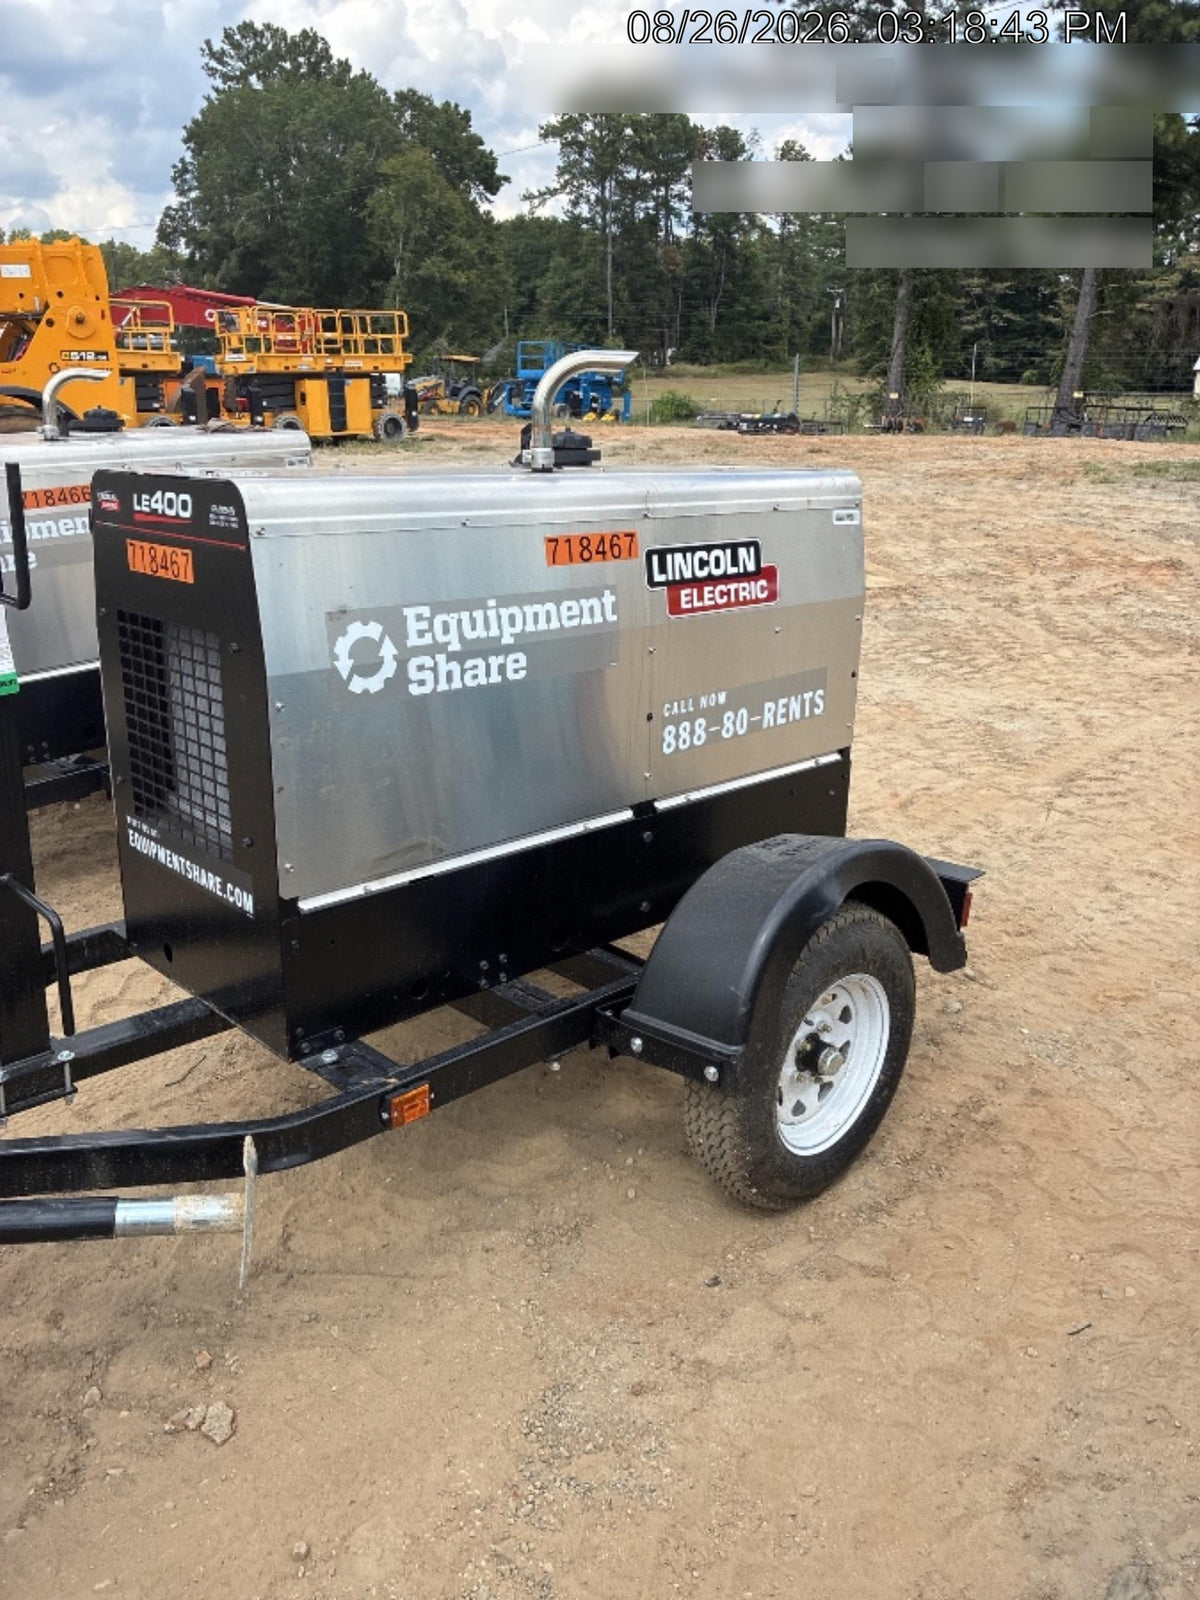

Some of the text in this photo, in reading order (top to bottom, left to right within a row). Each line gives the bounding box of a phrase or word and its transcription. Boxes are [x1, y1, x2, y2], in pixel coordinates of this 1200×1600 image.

[132, 490, 193, 518] LE400
[128, 542, 190, 580] 718467
[545, 532, 636, 564] 718467
[651, 546, 757, 583] LINCOLN
[679, 578, 769, 609] ELECTRIC
[403, 589, 618, 651] Equipment
[407, 651, 528, 696] Share
[662, 689, 825, 754] 888-80-RENTS
[663, 691, 728, 717] CALL NOW
[128, 828, 254, 914] EQUIPMENTSHARE.COM
